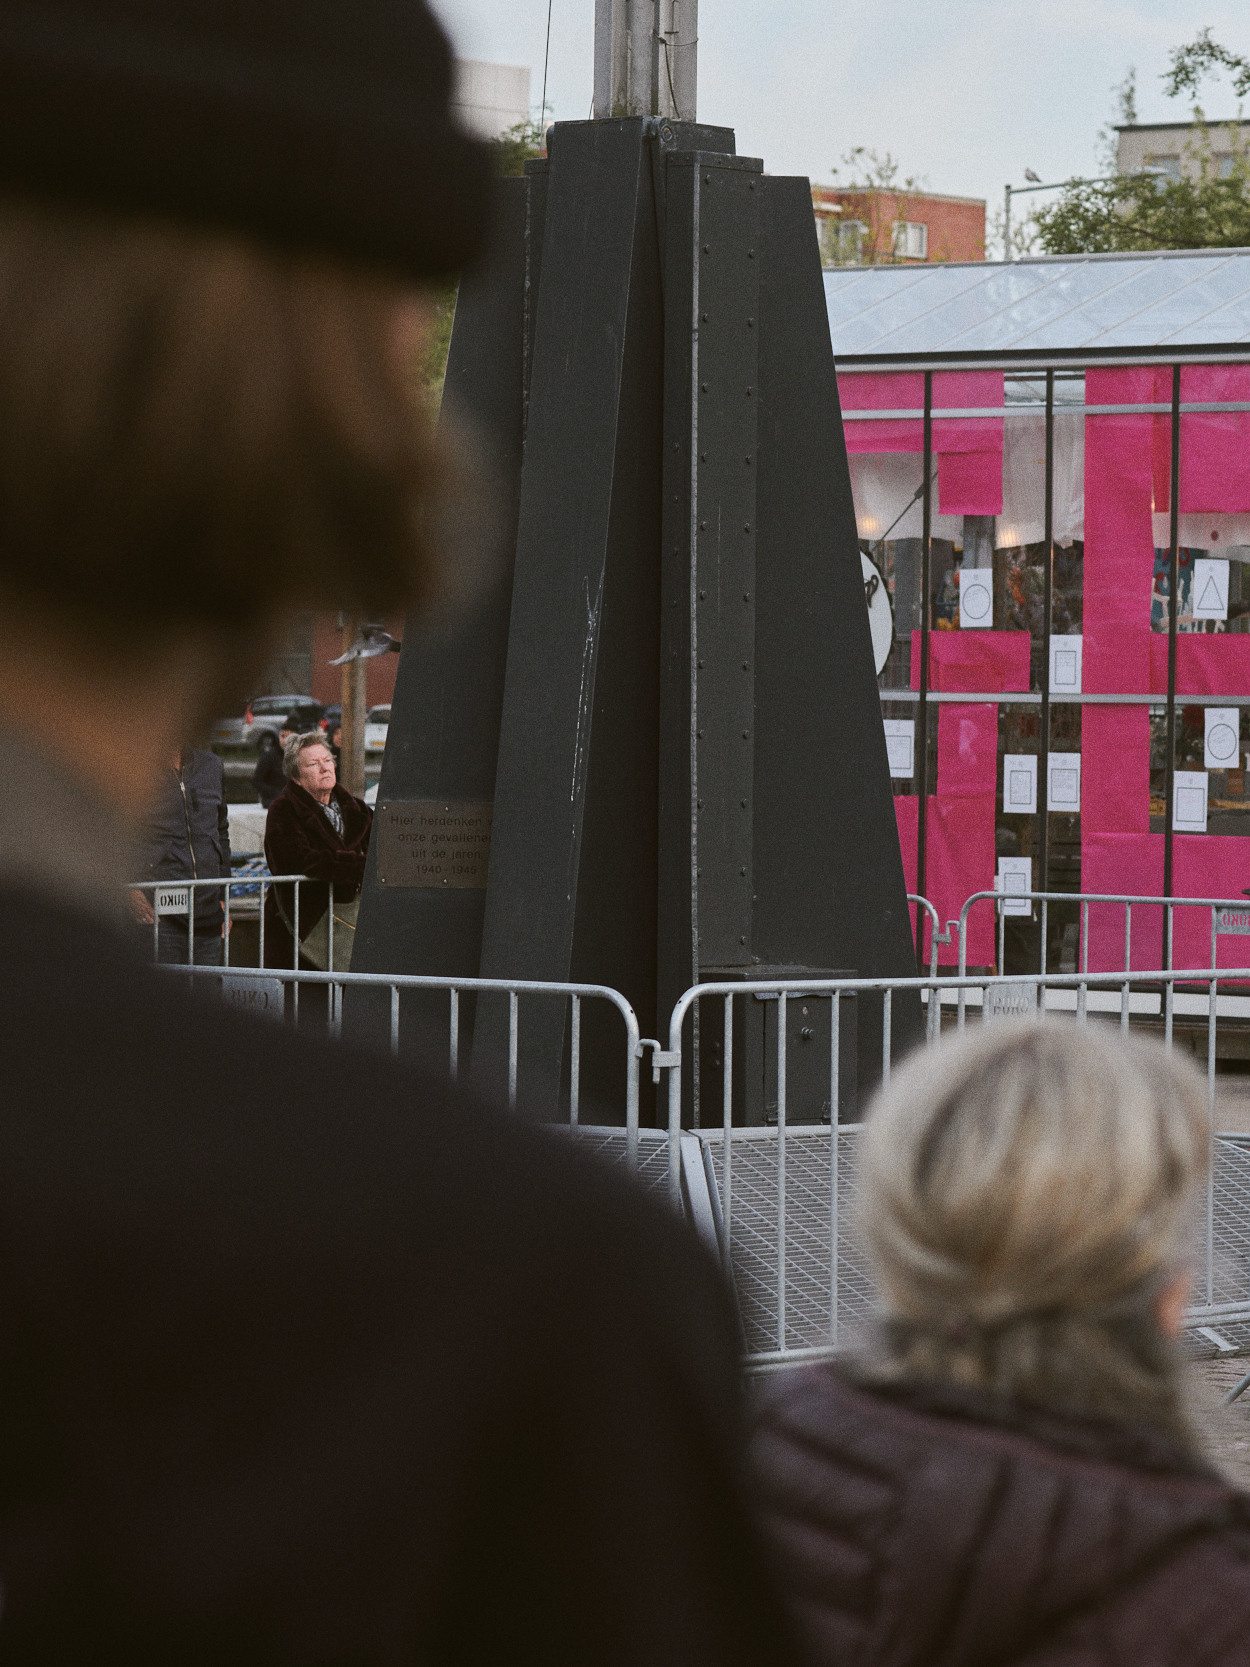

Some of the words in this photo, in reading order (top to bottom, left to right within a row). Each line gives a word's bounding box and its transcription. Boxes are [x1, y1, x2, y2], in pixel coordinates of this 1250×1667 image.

[390, 815, 414, 825] Hier
[420, 815, 482, 826] herdenken
[397, 833, 426, 842] onze
[411, 848, 426, 859] uit
[431, 849, 446, 859] de
[451, 849, 481, 861] jaren
